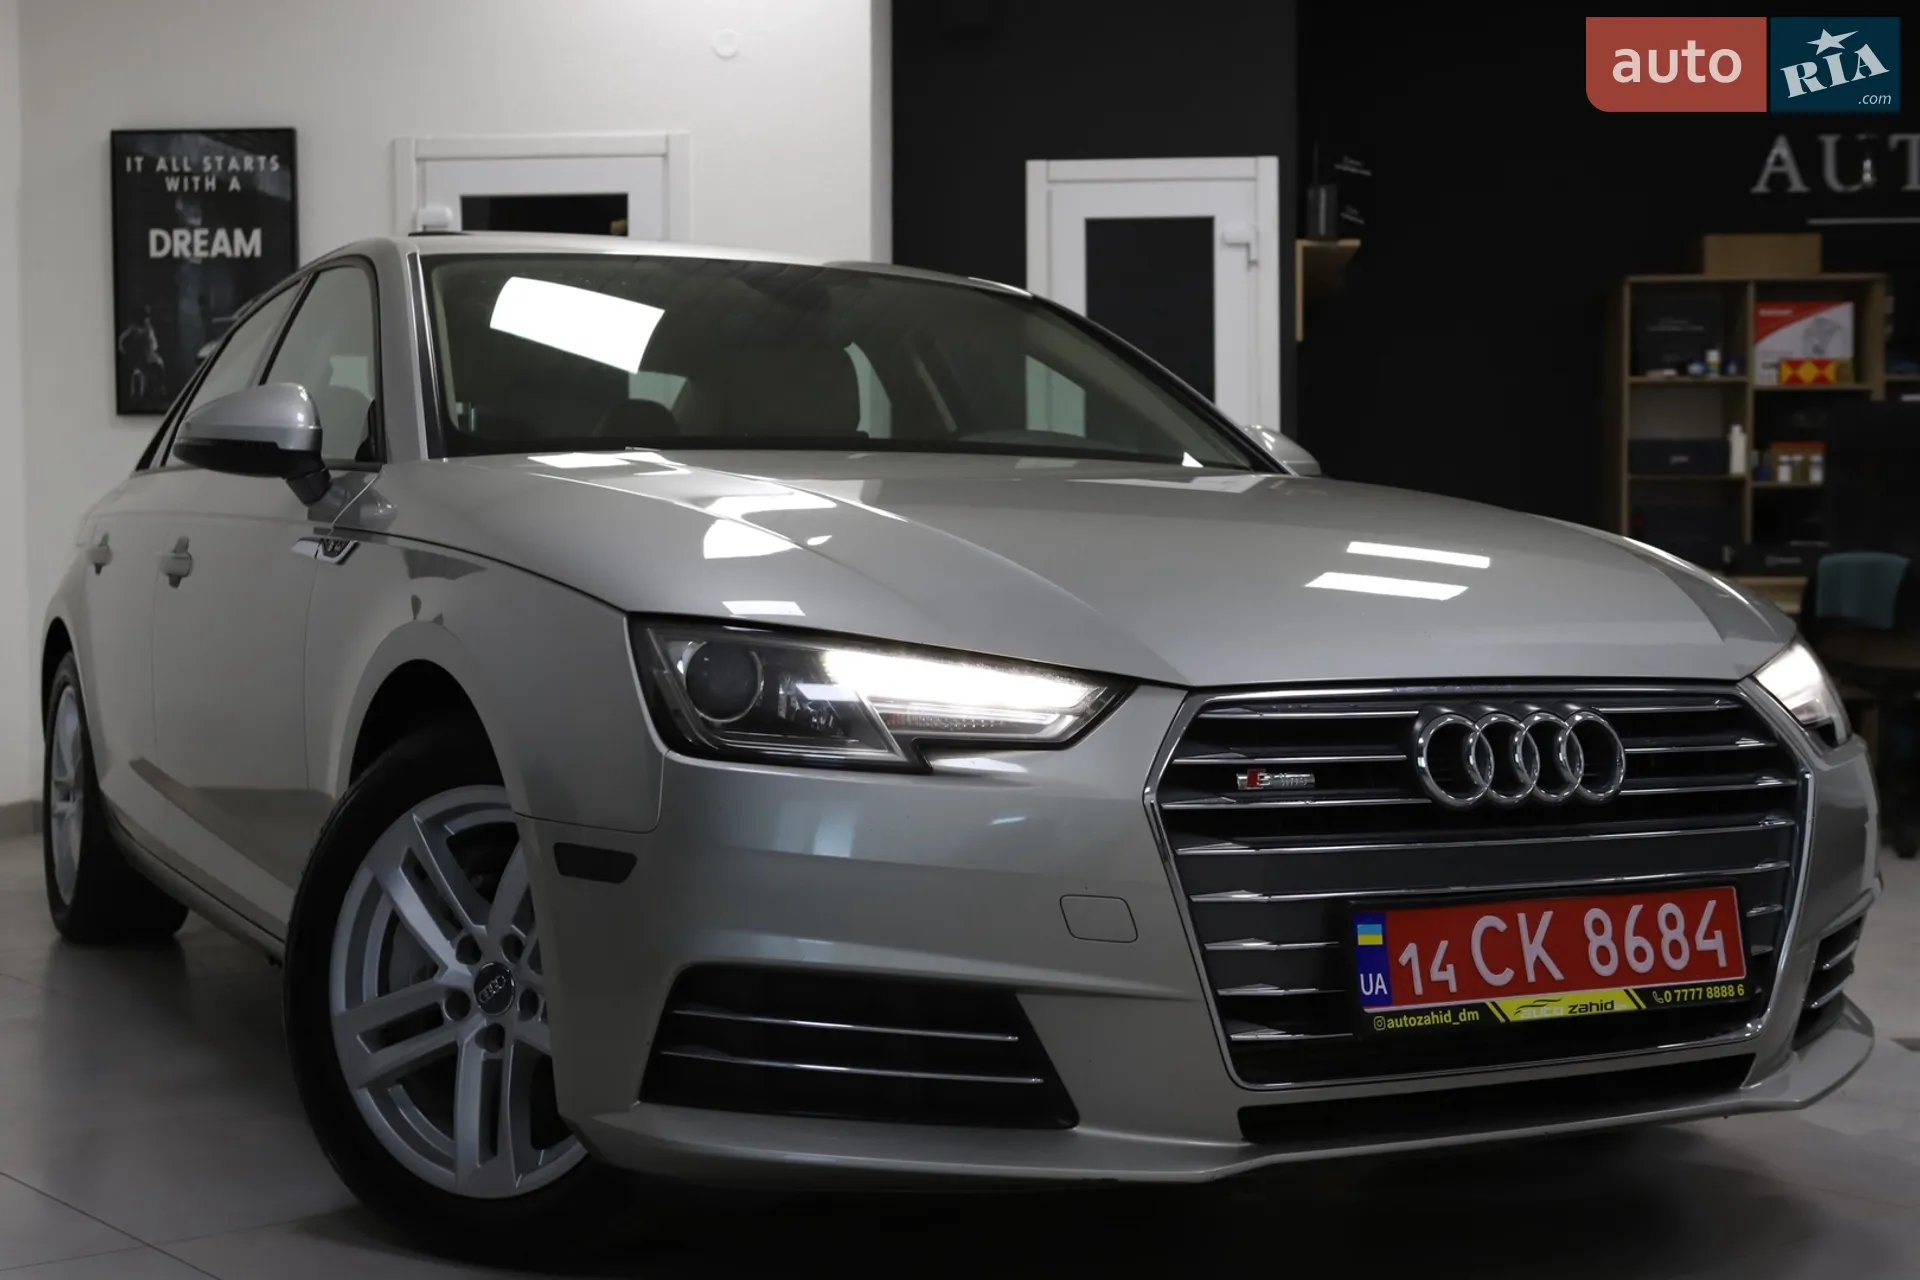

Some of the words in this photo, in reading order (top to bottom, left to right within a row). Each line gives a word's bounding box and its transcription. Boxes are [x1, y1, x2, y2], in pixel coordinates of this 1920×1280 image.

[125, 156, 144, 173] IT
[156, 156, 191, 173] ALL
[202, 155, 280, 172] STARTS
[165, 175, 217, 192] WITH
[228, 176, 241, 192] A
[149, 228, 262, 258] DREAM
[1399, 940, 1457, 996] 14
[1471, 911, 1564, 987] CK
[1583, 899, 1728, 977] 8684
[1360, 973, 1388, 996] UA
[1568, 1000, 1615, 1014] zahid
